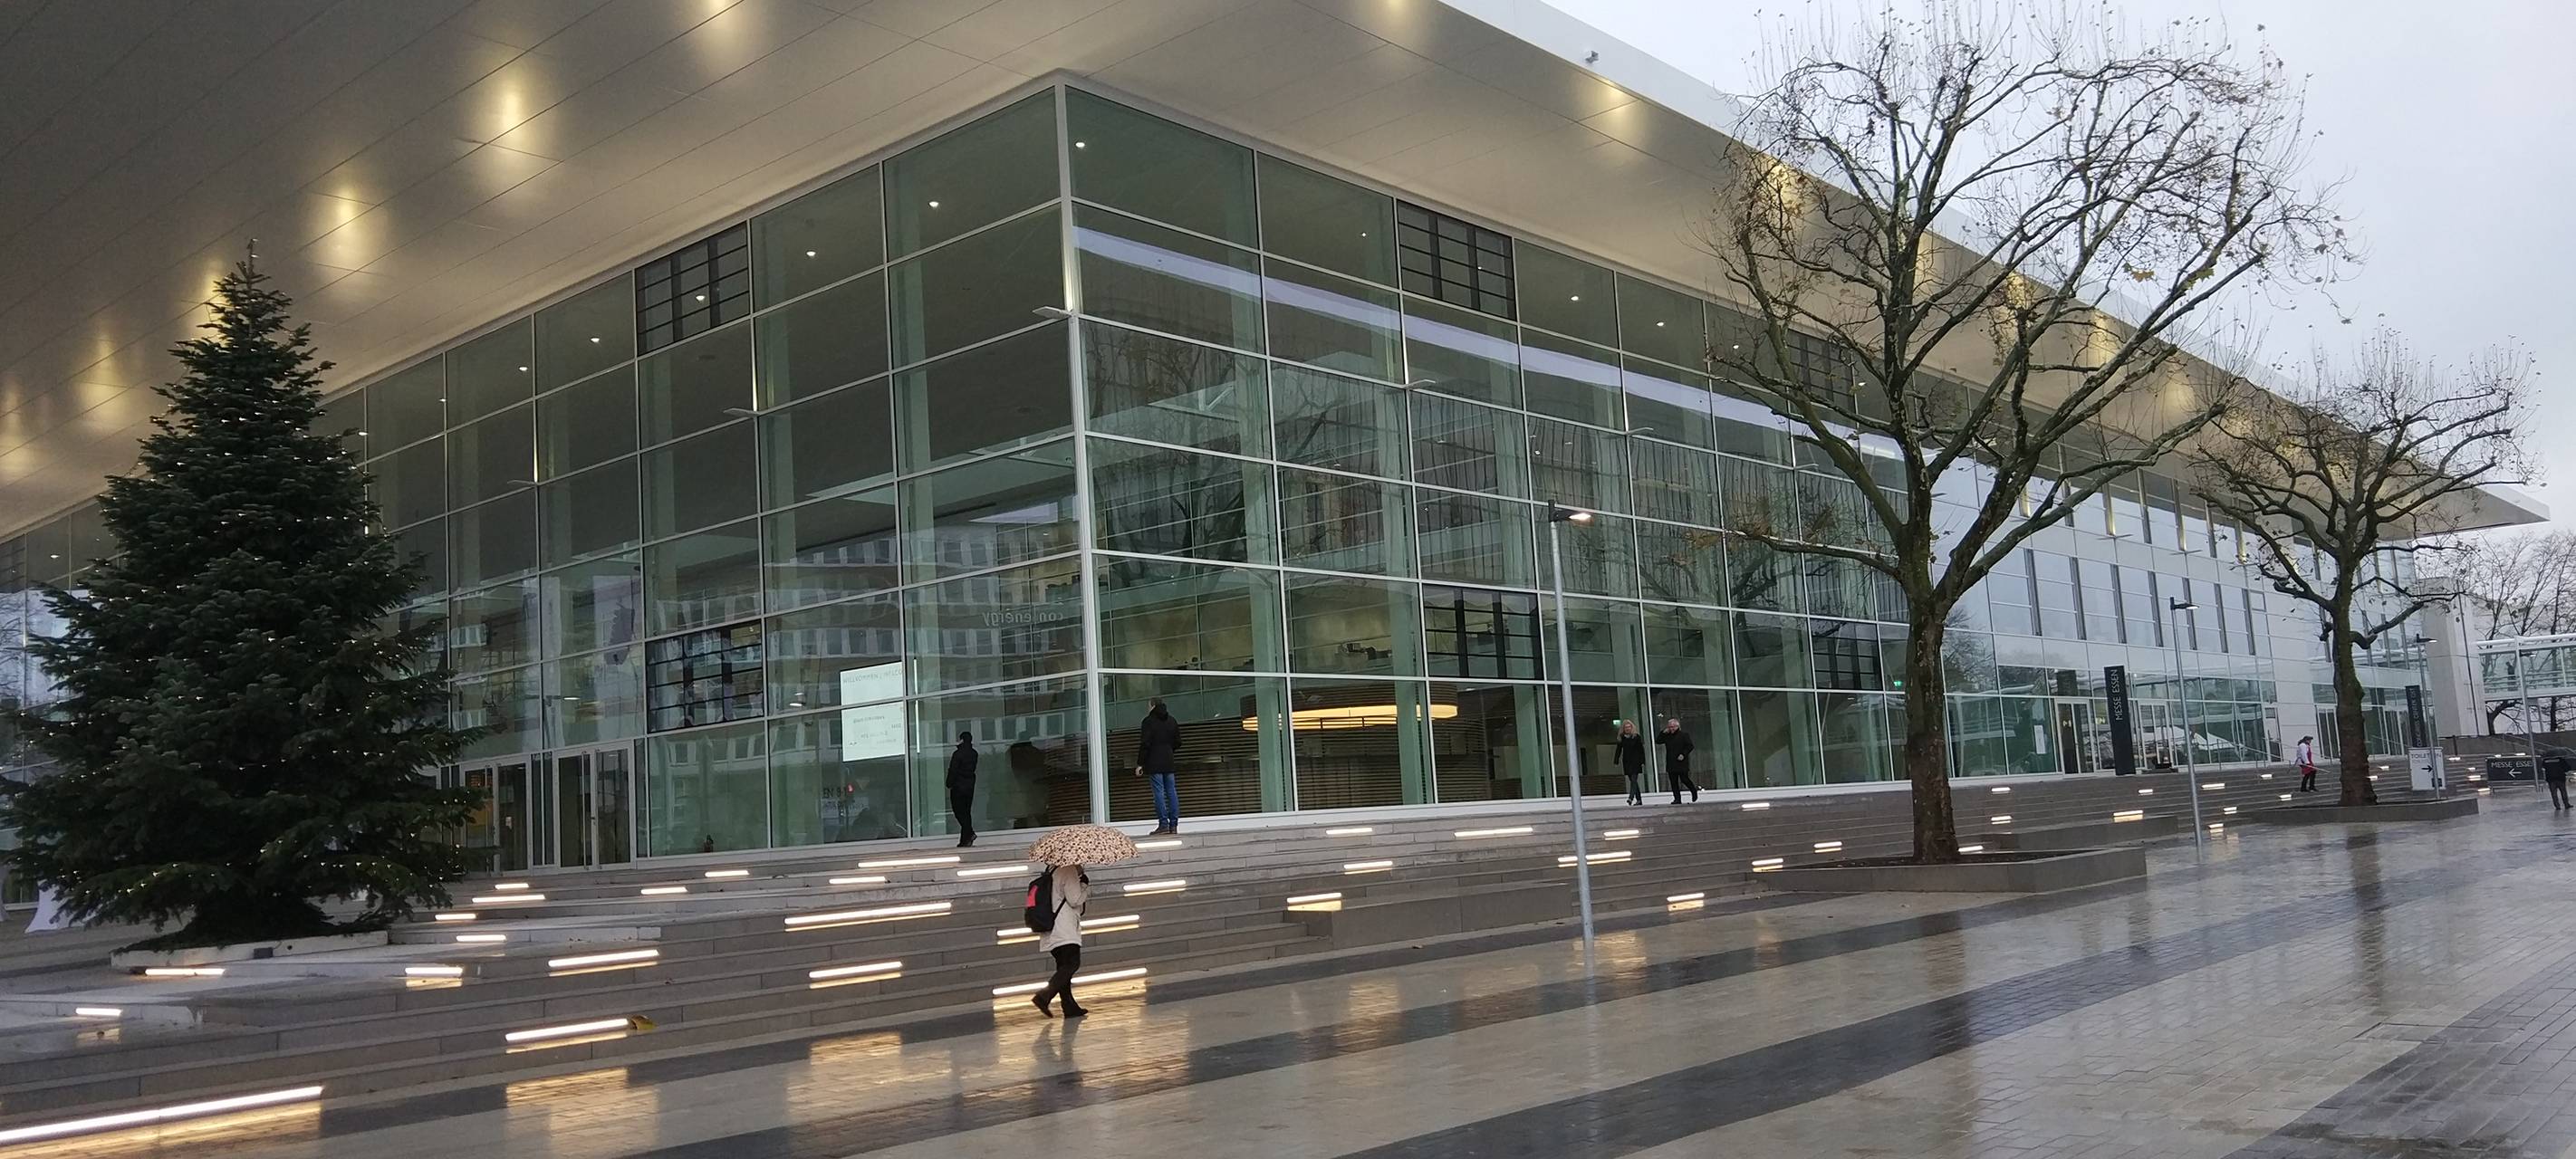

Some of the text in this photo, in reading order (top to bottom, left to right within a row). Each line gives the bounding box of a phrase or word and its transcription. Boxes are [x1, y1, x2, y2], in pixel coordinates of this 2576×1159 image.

[2110, 669, 2124, 721] MESSE ESSEN
[2491, 760, 2534, 769] MESSE ESSE
